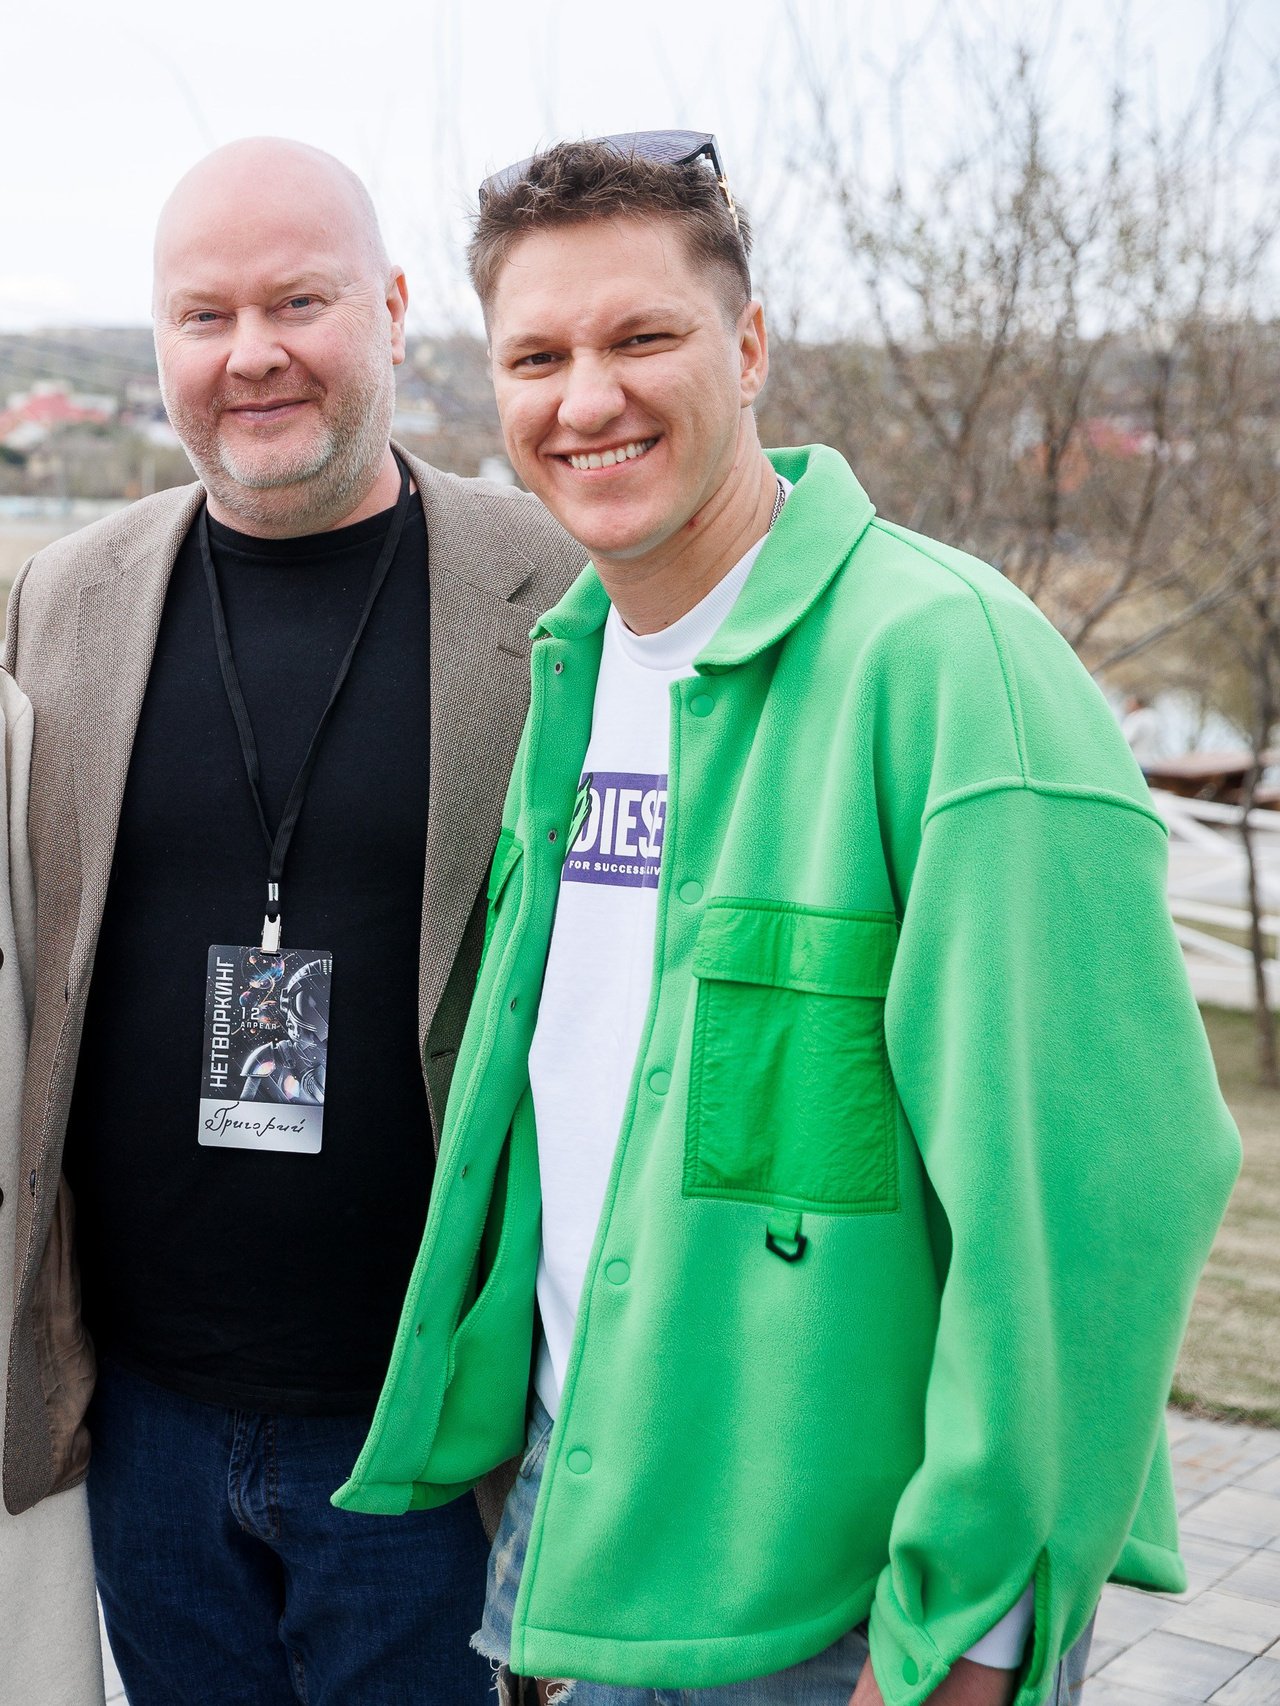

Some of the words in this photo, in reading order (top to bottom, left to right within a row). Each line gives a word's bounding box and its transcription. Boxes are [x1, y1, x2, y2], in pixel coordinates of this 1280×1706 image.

[571, 787, 668, 859] DIESE
[568, 859, 591, 870] FOR
[209, 956, 235, 1088] НЕТВОРКИНГ
[240, 1021, 277, 1030] АПРЕЛЯ
[241, 1006, 261, 1020] 12
[204, 1101, 306, 1137] Григорий
